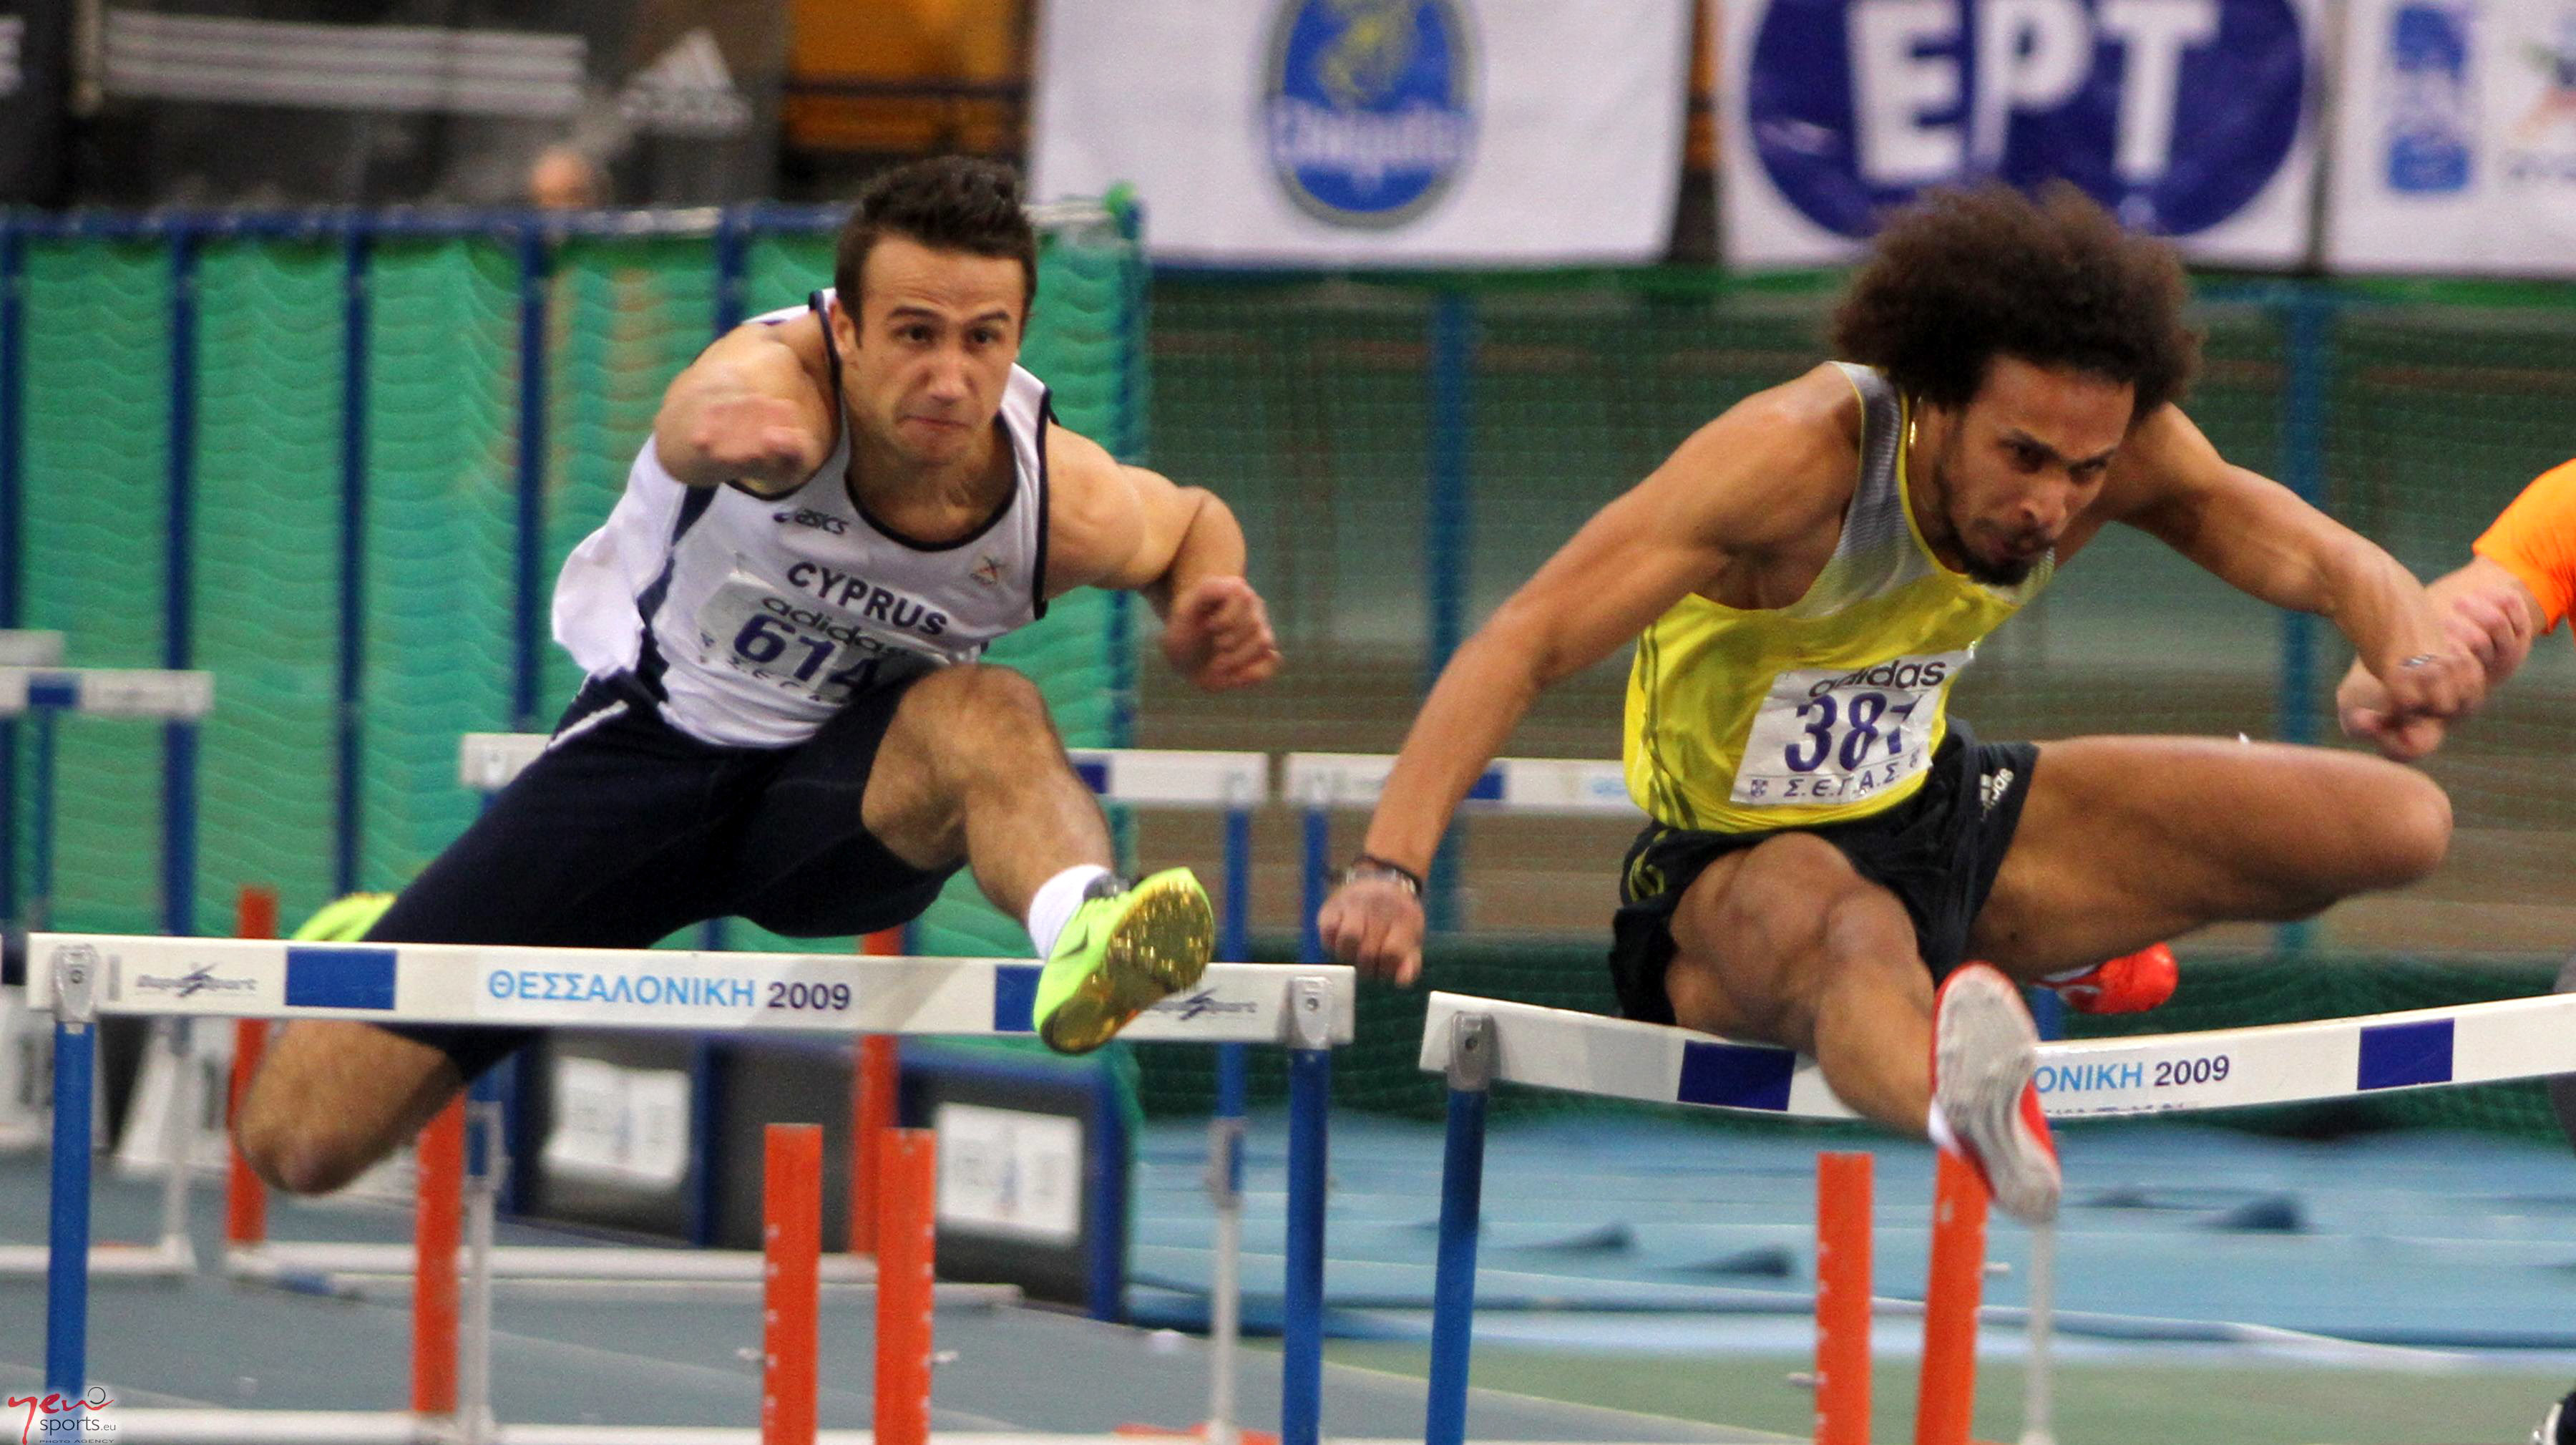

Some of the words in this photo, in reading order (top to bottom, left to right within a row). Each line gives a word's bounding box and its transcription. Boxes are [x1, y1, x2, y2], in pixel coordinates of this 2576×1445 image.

[787, 561, 947, 636] CYPRUS
[734, 613, 882, 691] 614
[488, 969, 756, 1007] ΘΕΣΣΑΛΟΝΙΚΗ
[767, 981, 851, 1011] 2009
[2154, 1054, 2230, 1087] 2009
